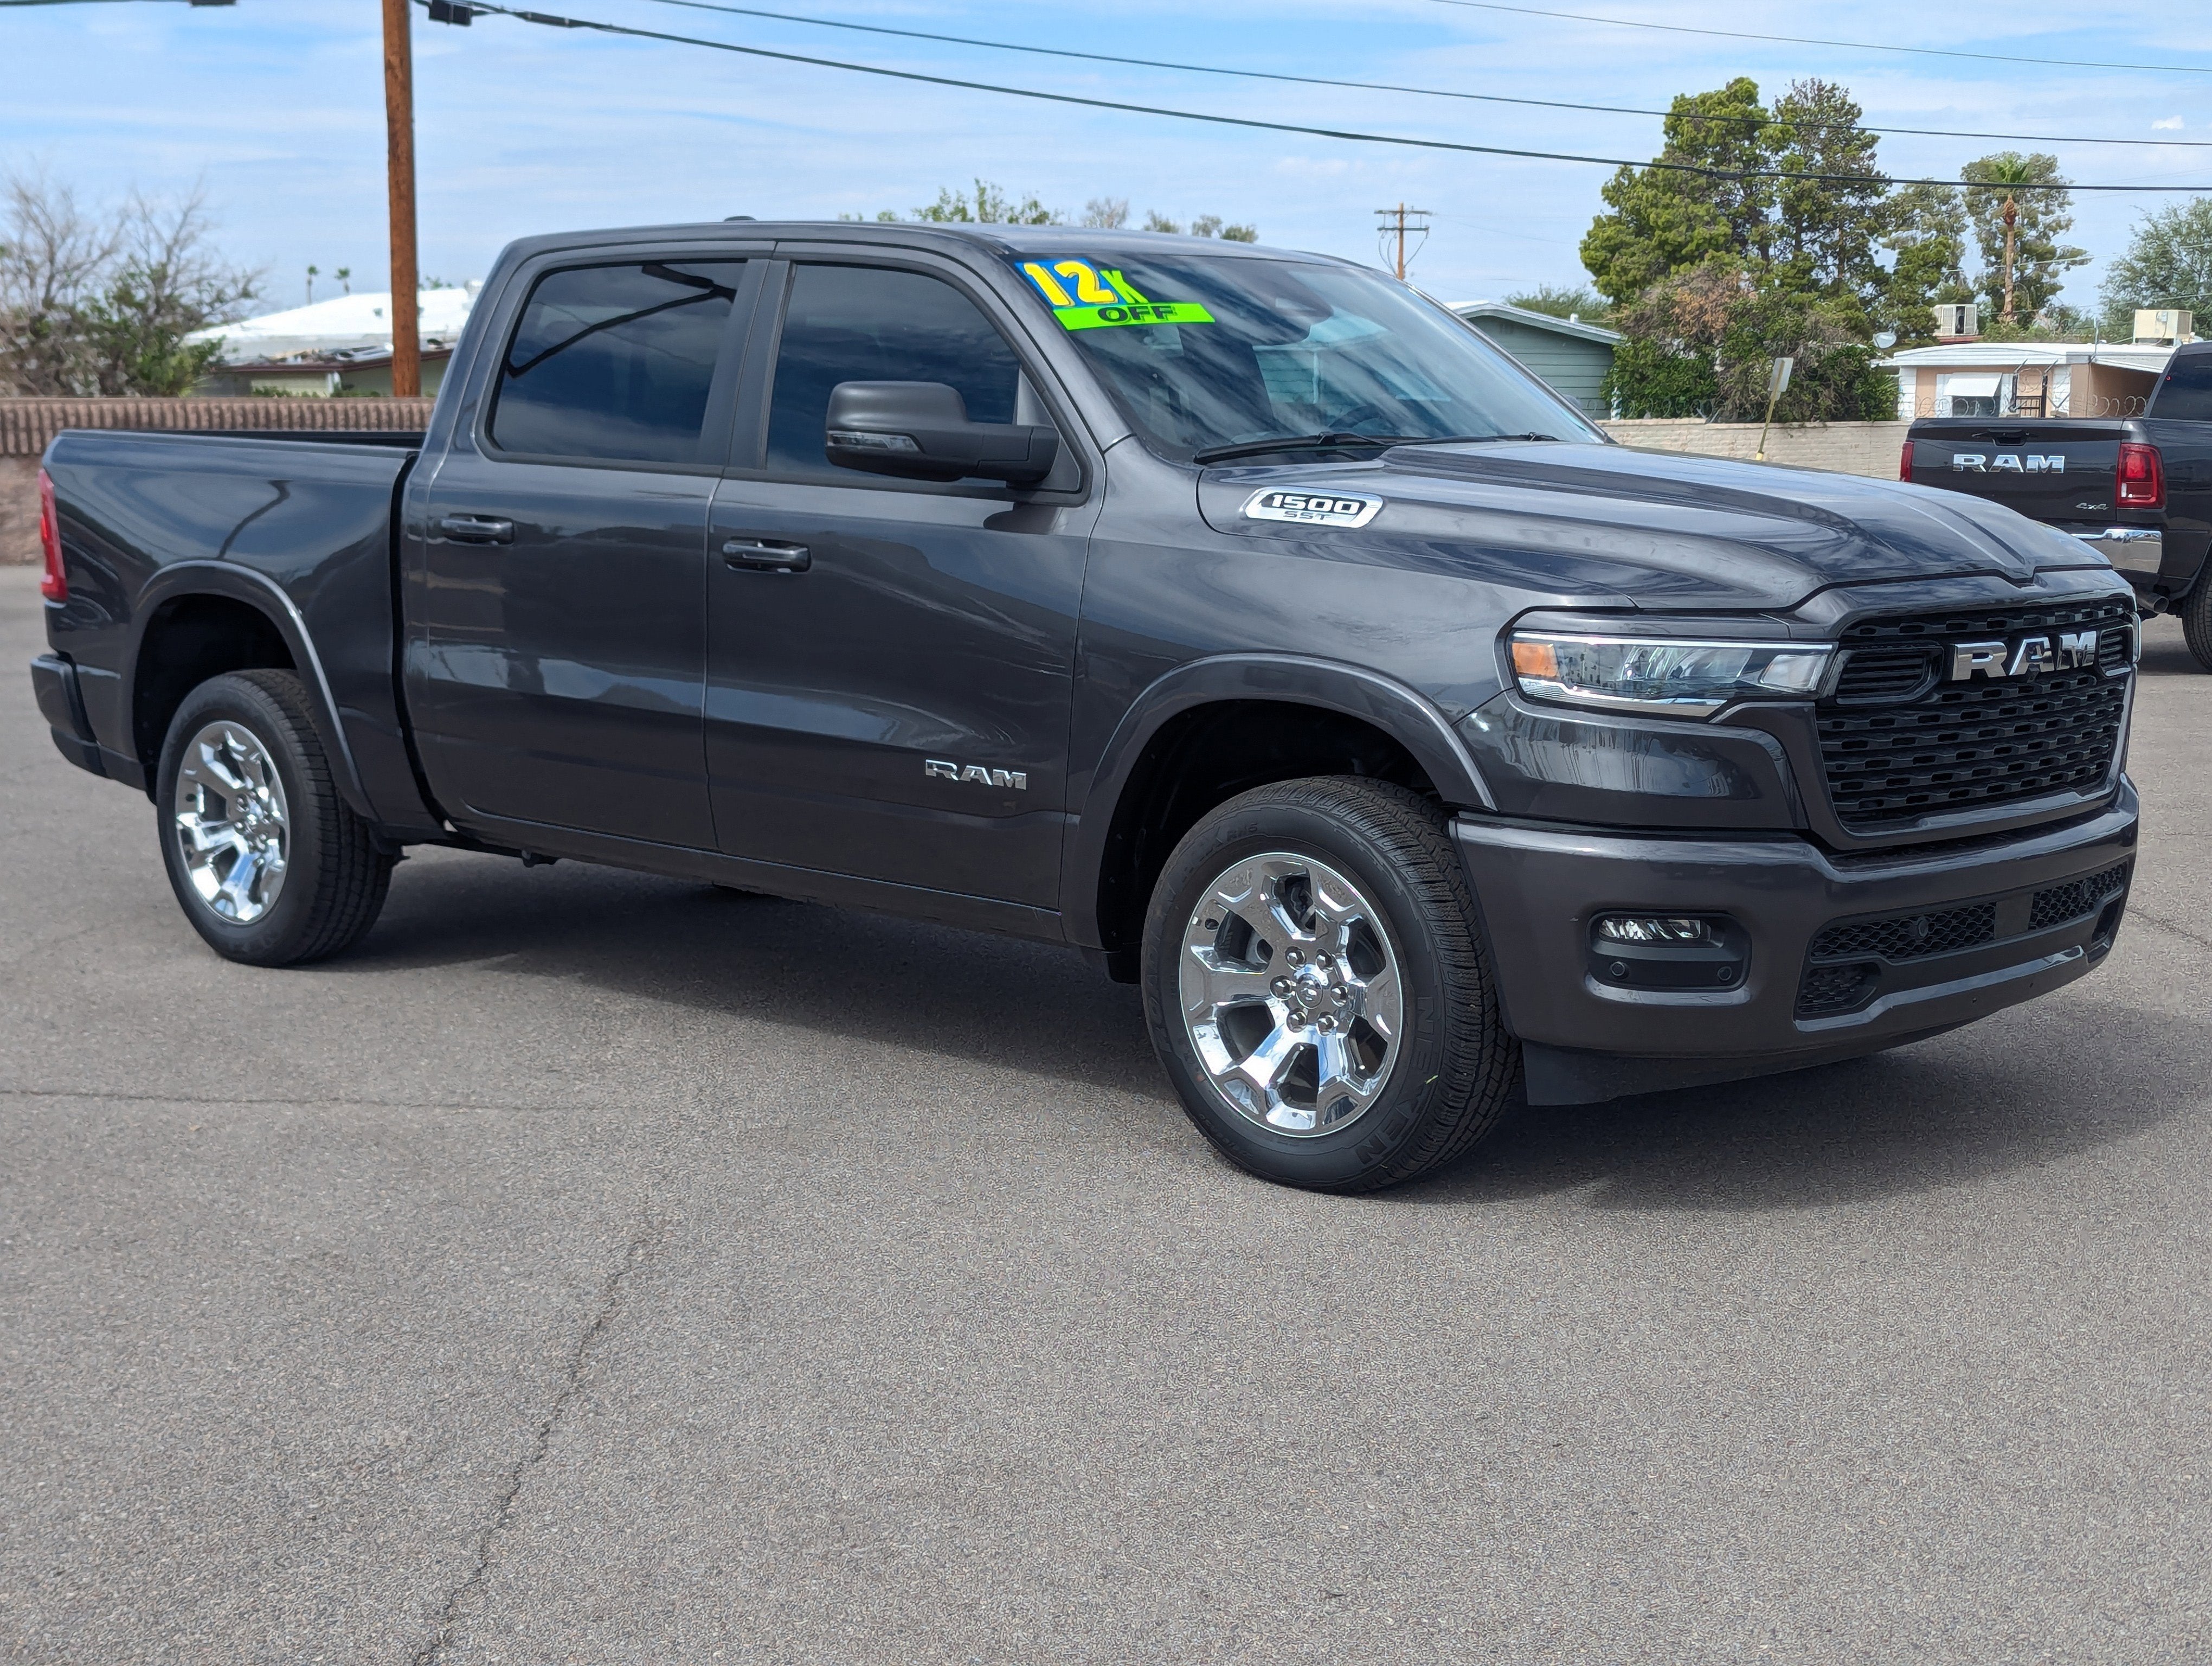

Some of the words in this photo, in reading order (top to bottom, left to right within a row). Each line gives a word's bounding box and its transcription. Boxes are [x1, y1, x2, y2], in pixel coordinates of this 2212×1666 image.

[1098, 305, 1174, 323] OFF
[1952, 453, 2065, 474] RAM
[1272, 495, 1360, 515] 1500
[1283, 511, 1331, 521] SST
[1952, 630, 2097, 681] RAM
[925, 759, 1027, 790] RAM
